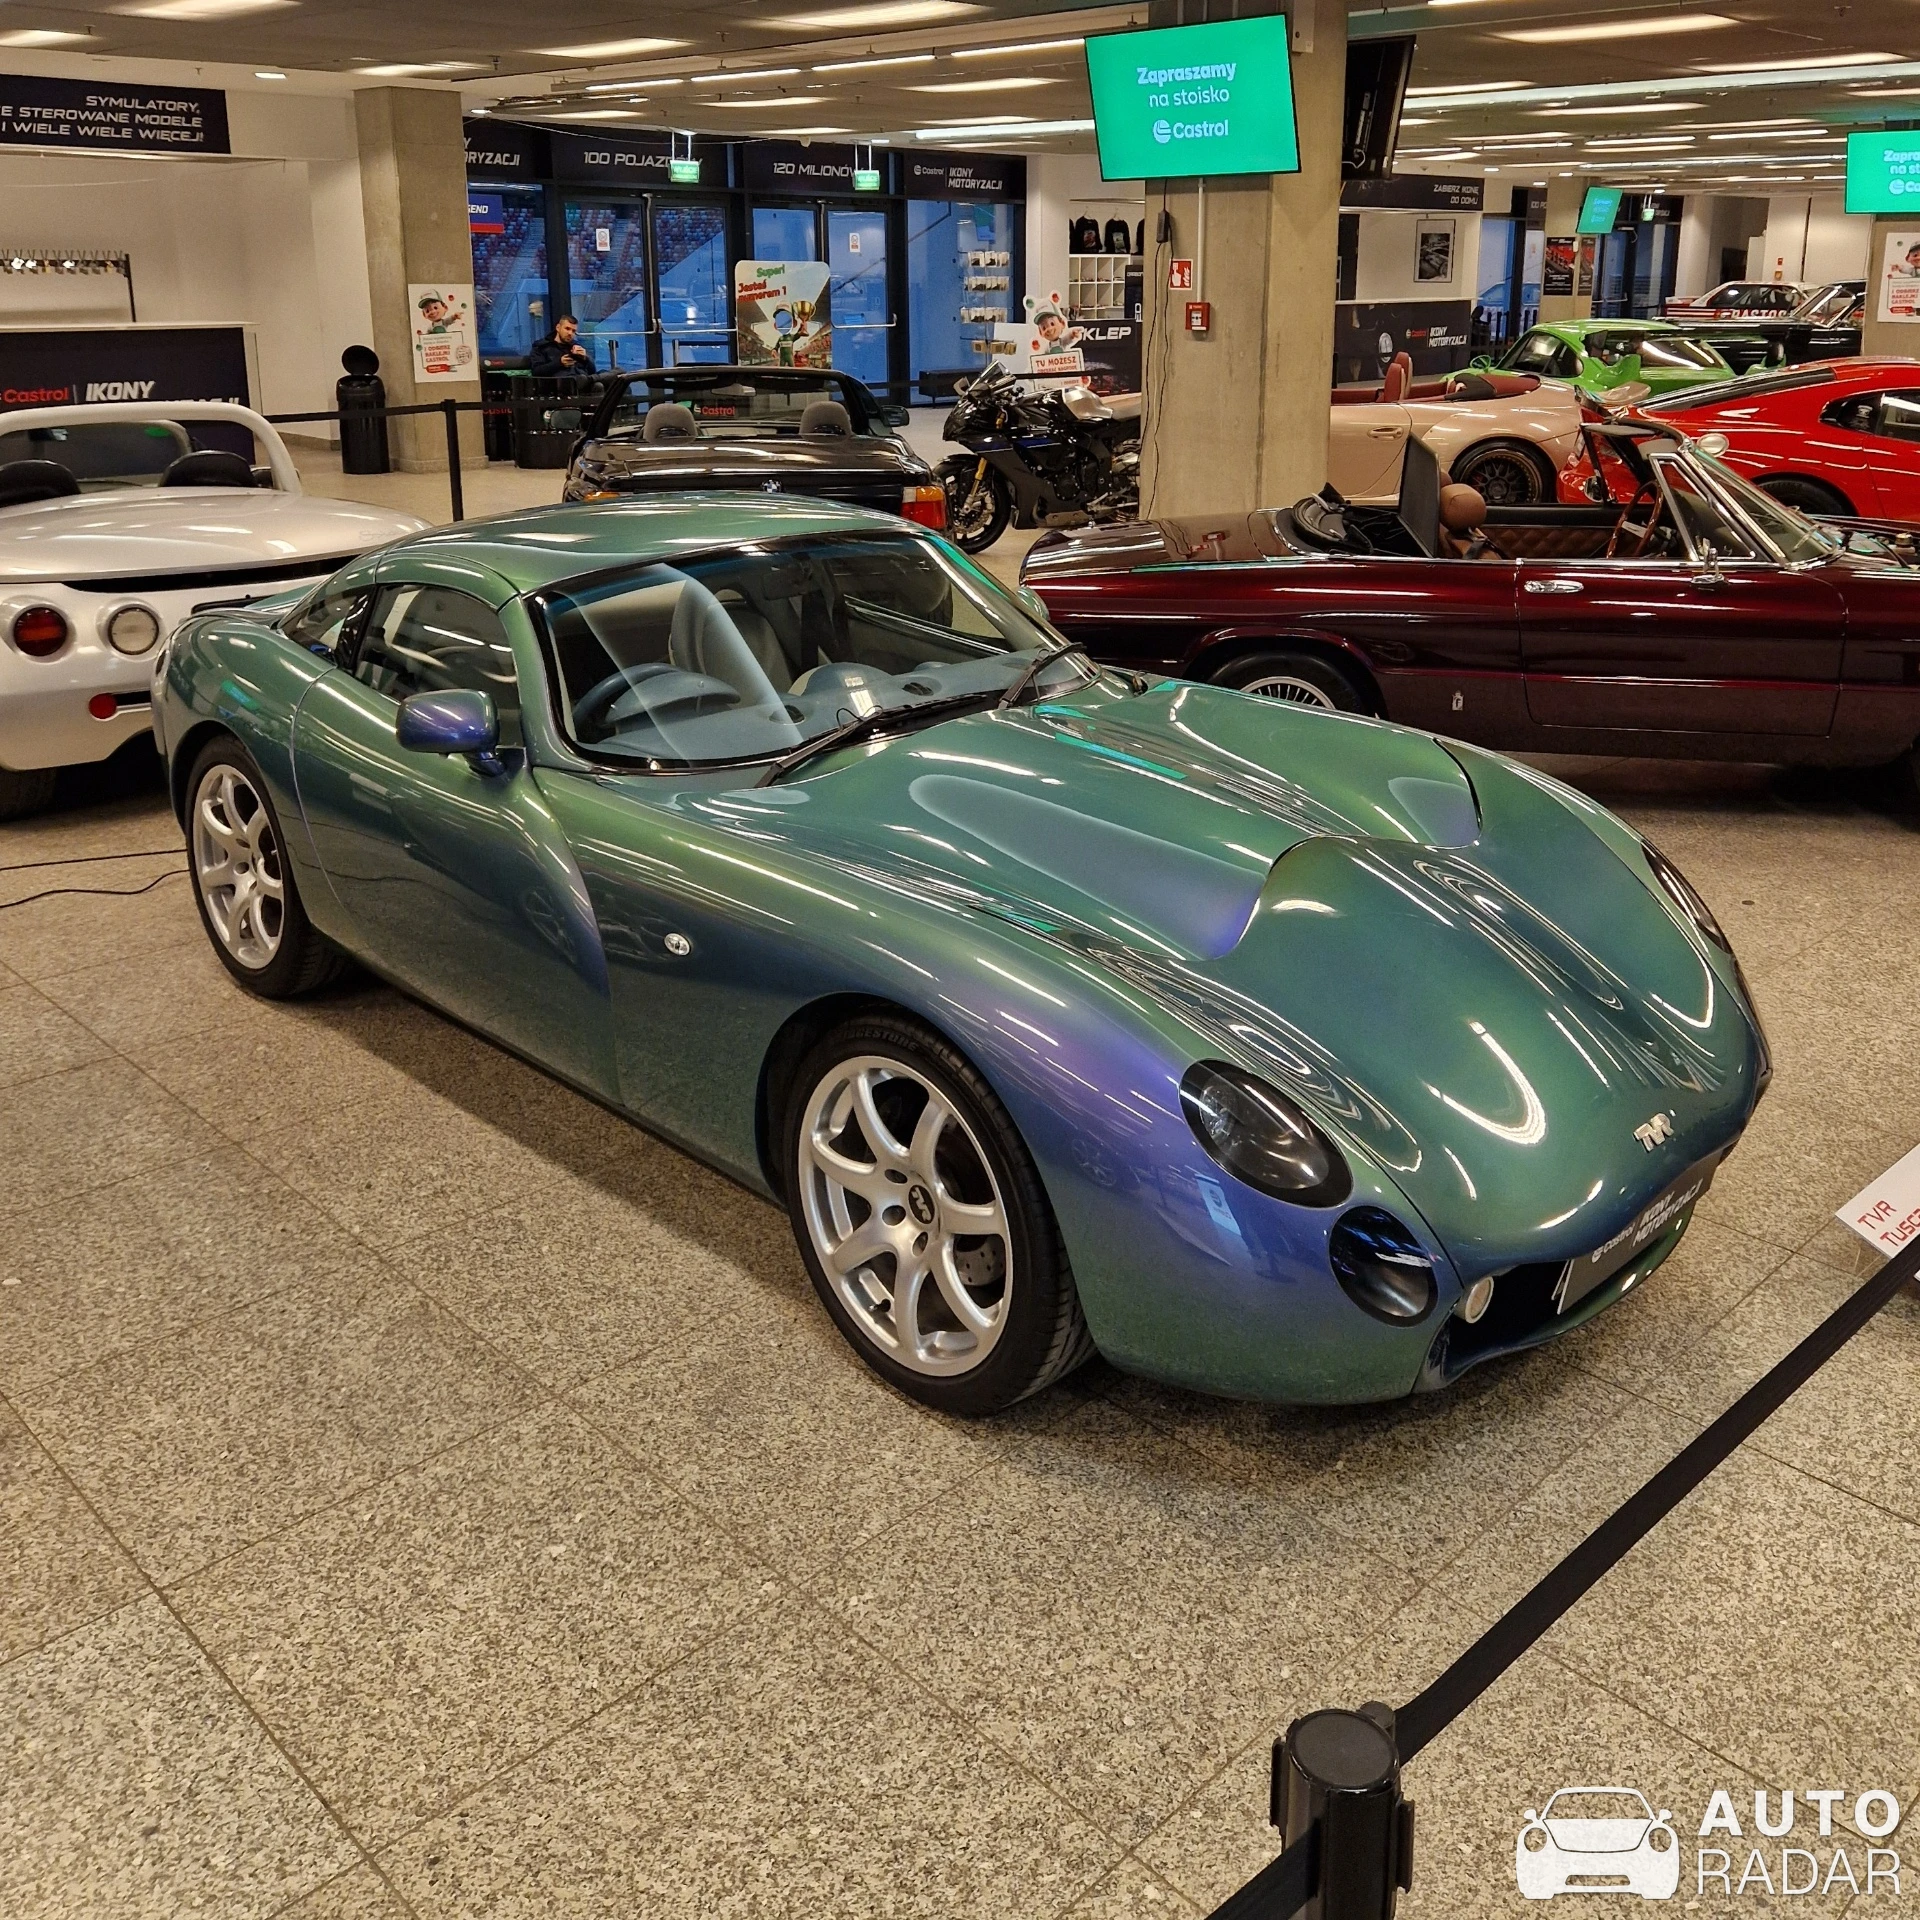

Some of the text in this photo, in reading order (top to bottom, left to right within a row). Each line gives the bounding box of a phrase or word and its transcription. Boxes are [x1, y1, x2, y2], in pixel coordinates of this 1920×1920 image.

[1136, 62, 1237, 88] Zapraszamy
[86, 95, 201, 114] SYMULATORY,
[1149, 85, 1230, 108] na stoisko
[19, 106, 130, 124] STEROWANE
[135, 114, 203, 128] MODELE
[1, 122, 204, 143] I WIELE WIELE WIĘCEJ!
[1172, 119, 1229, 139] Castrol
[584, 151, 611, 164] 100
[773, 162, 796, 175] 120
[922, 166, 945, 175] Castrol
[949, 167, 974, 178] IKONY
[948, 178, 1003, 190] MOTORYZACJI
[1433, 184, 1461, 193] ZABIERZ
[1430, 326, 1448, 337] IKONY
[3, 387, 70, 403] Castrol
[86, 380, 156, 402] IKONY
[701, 405, 736, 416] Castrol
[1857, 1200, 1897, 1230] TVR
